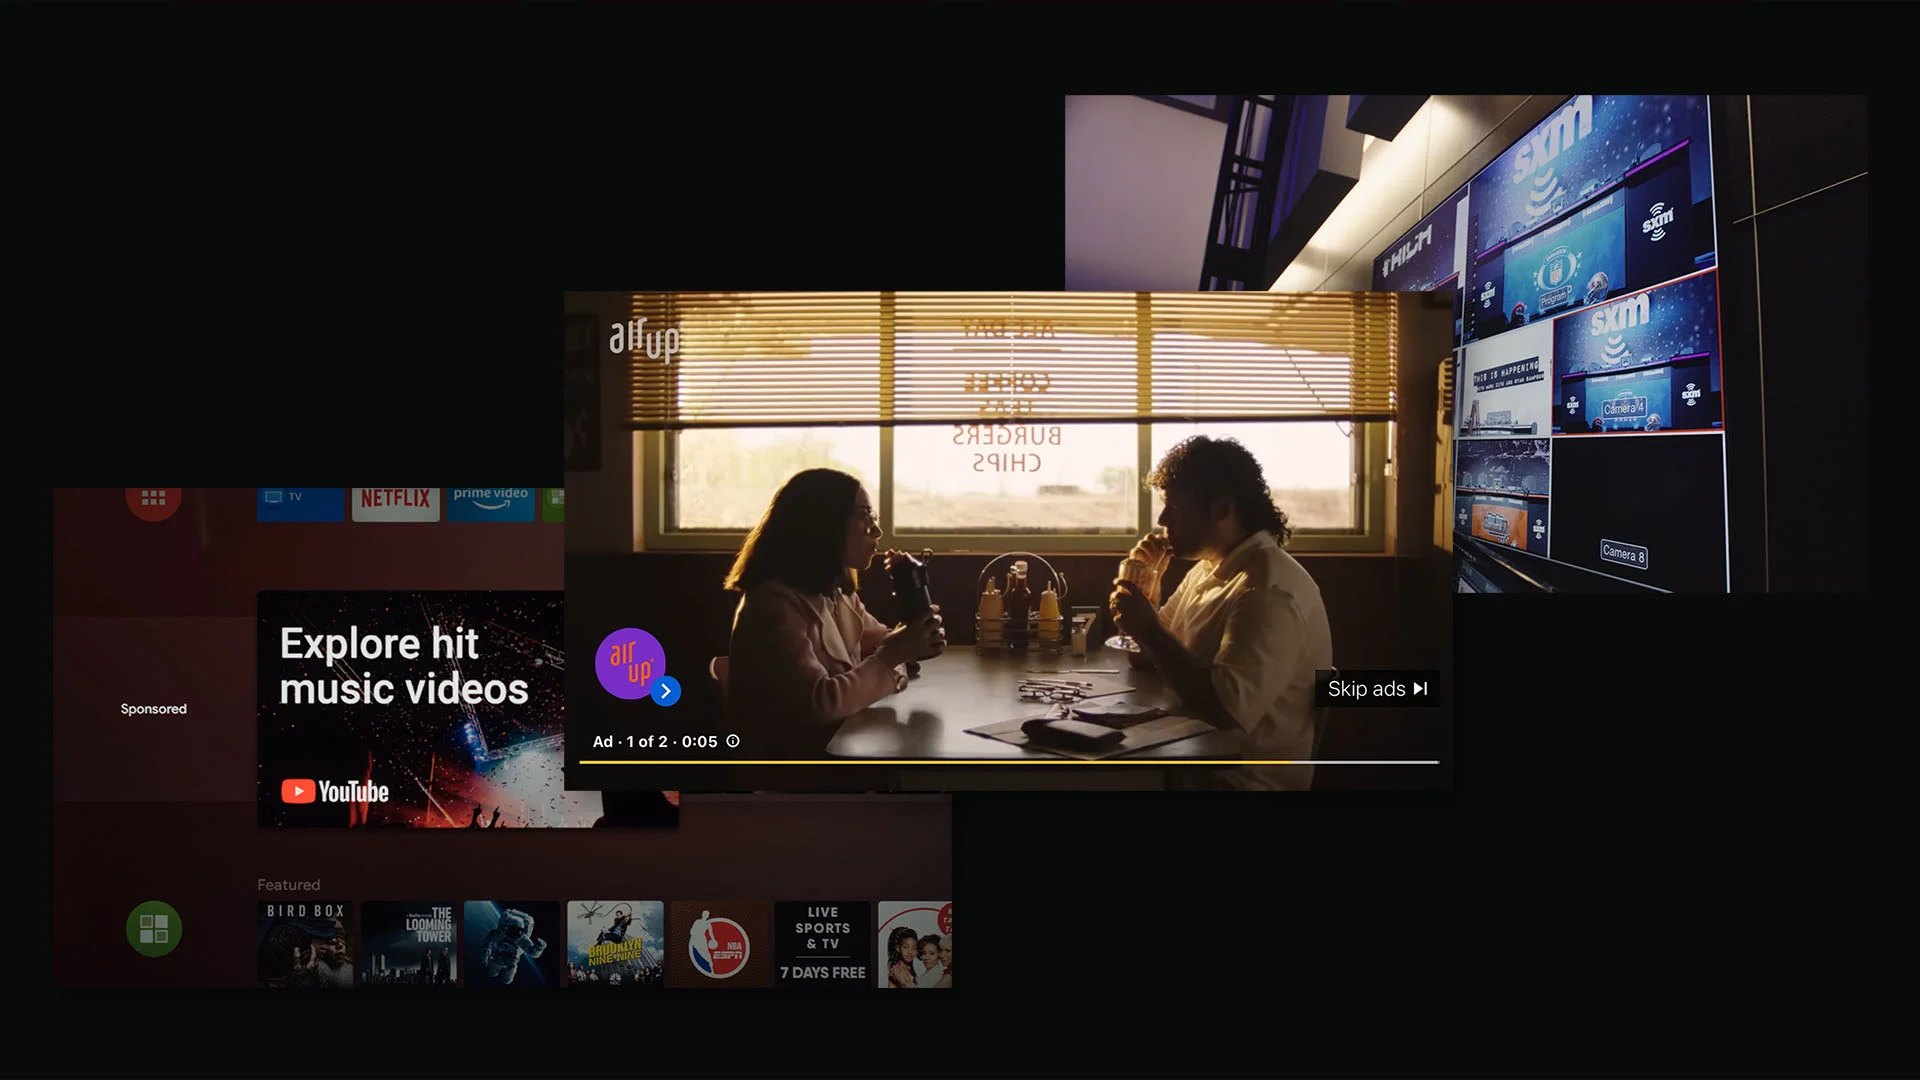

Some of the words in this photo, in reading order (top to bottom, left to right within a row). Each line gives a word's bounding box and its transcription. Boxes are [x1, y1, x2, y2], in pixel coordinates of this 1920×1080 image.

[1513, 95, 1593, 184] sxm
[1642, 207, 1675, 234] sxm
[1541, 291, 1567, 306] Program
[1591, 293, 1650, 336] sxm
[1501, 360, 1539, 377] HAPPENING
[1604, 402, 1635, 415] Camera
[1638, 402, 1644, 412] 4
[289, 492, 303, 501] TV
[361, 488, 430, 508] NETFLIX
[454, 488, 491, 501] prime
[493, 488, 528, 499] video
[1603, 544, 1636, 562] Camera
[1638, 552, 1645, 564] 8
[280, 625, 420, 667] Explore
[432, 625, 479, 660] hit
[280, 671, 394, 705] music
[404, 671, 529, 706] videos
[120, 702, 188, 717] Sponsored
[319, 779, 389, 803] YouTube
[258, 878, 321, 891] Featured
[267, 904, 306, 917] BIRD
[314, 904, 344, 917] BOX
[432, 906, 452, 919] THE
[808, 906, 838, 918] LIVE
[406, 918, 452, 931] LOOMING
[795, 922, 850, 934] SPORTS
[416, 930, 452, 943] TOWER
[727, 942, 743, 950] NBA
[806, 938, 817, 949] &
[822, 938, 839, 949] TV
[712, 951, 743, 960] ESPN
[780, 966, 789, 979] 7
[792, 966, 829, 979] DAYS
[832, 966, 866, 979] FREE
